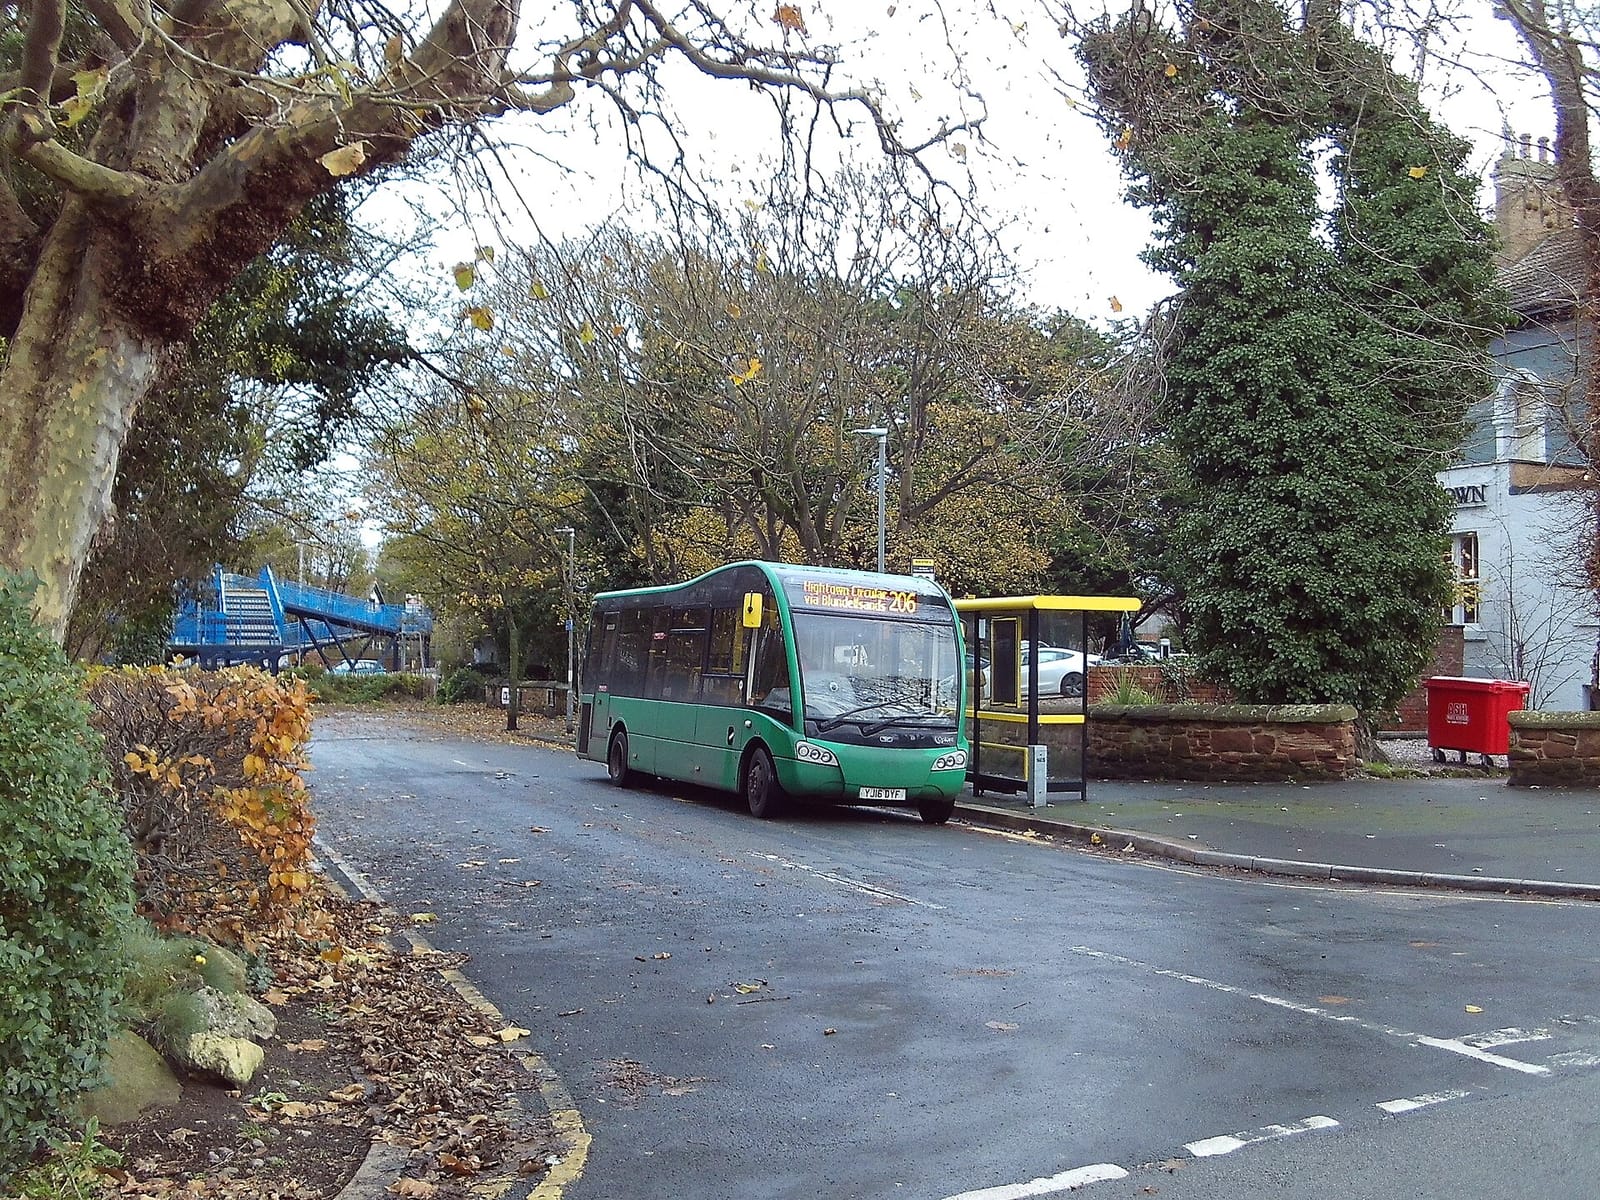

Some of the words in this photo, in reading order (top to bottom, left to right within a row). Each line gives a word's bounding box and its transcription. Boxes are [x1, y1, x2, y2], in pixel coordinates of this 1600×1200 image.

[803, 580, 849, 596] Hightown
[851, 585, 888, 600] Circular
[803, 594, 819, 606] via
[821, 595, 887, 612] Blundellsands
[888, 590, 917, 613] 206
[864, 788, 883, 798] YJ16
[884, 789, 901, 799] DYF
